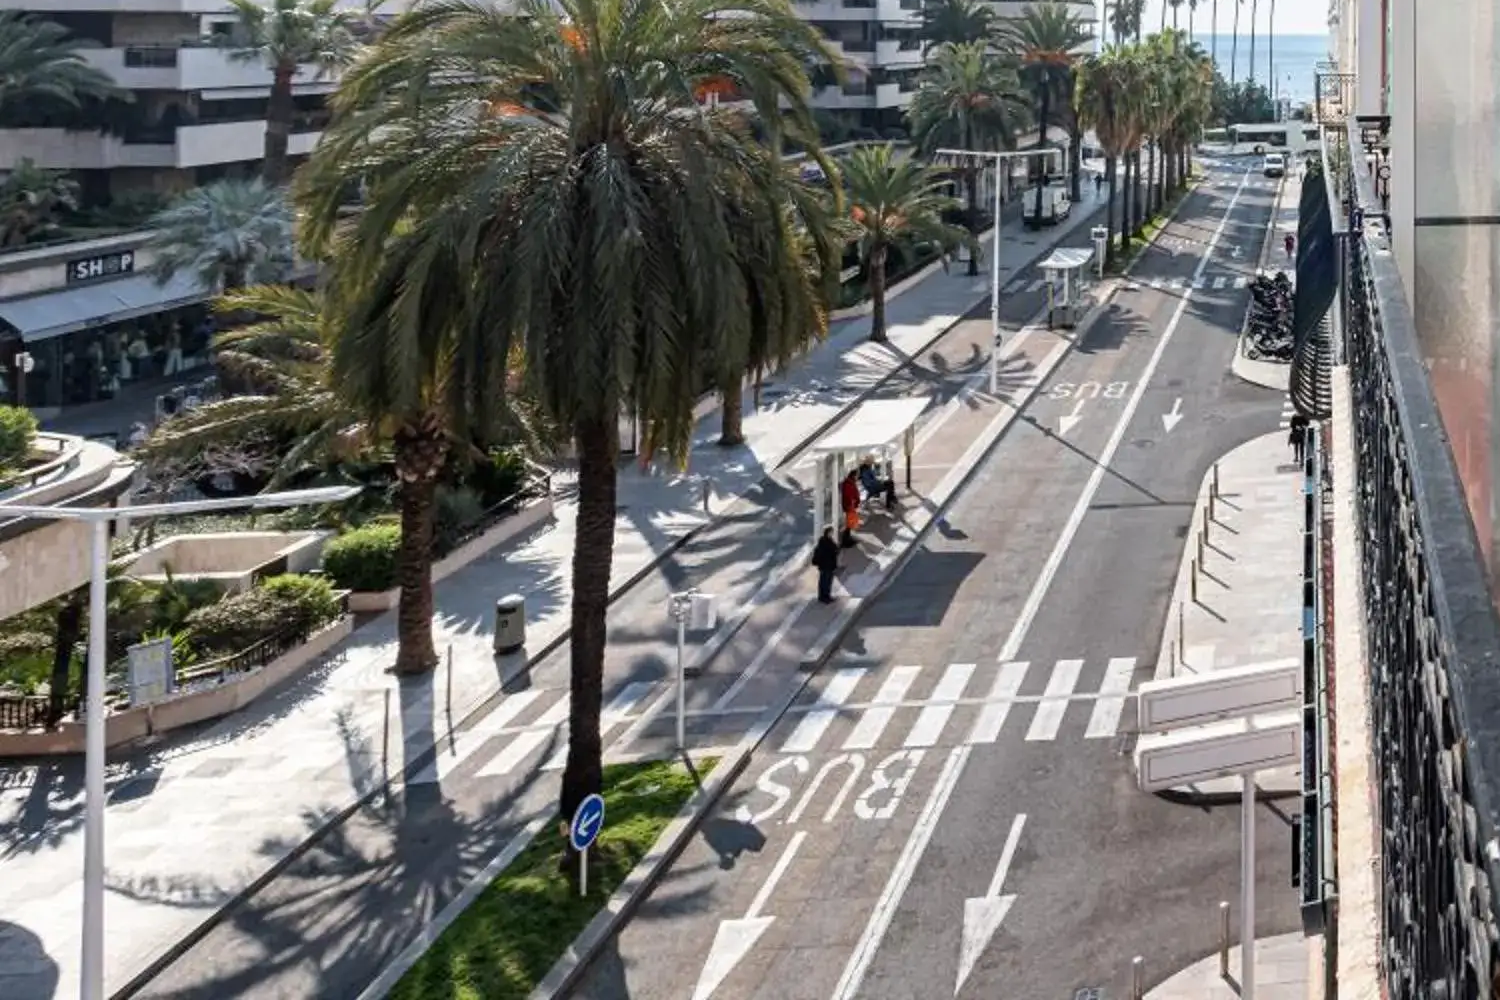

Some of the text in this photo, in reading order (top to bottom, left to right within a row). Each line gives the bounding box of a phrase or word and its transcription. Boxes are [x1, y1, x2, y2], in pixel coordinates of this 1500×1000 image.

[77, 254, 132, 279] SHP
[1049, 381, 1129, 399] BUS
[735, 749, 926, 825] BUS
